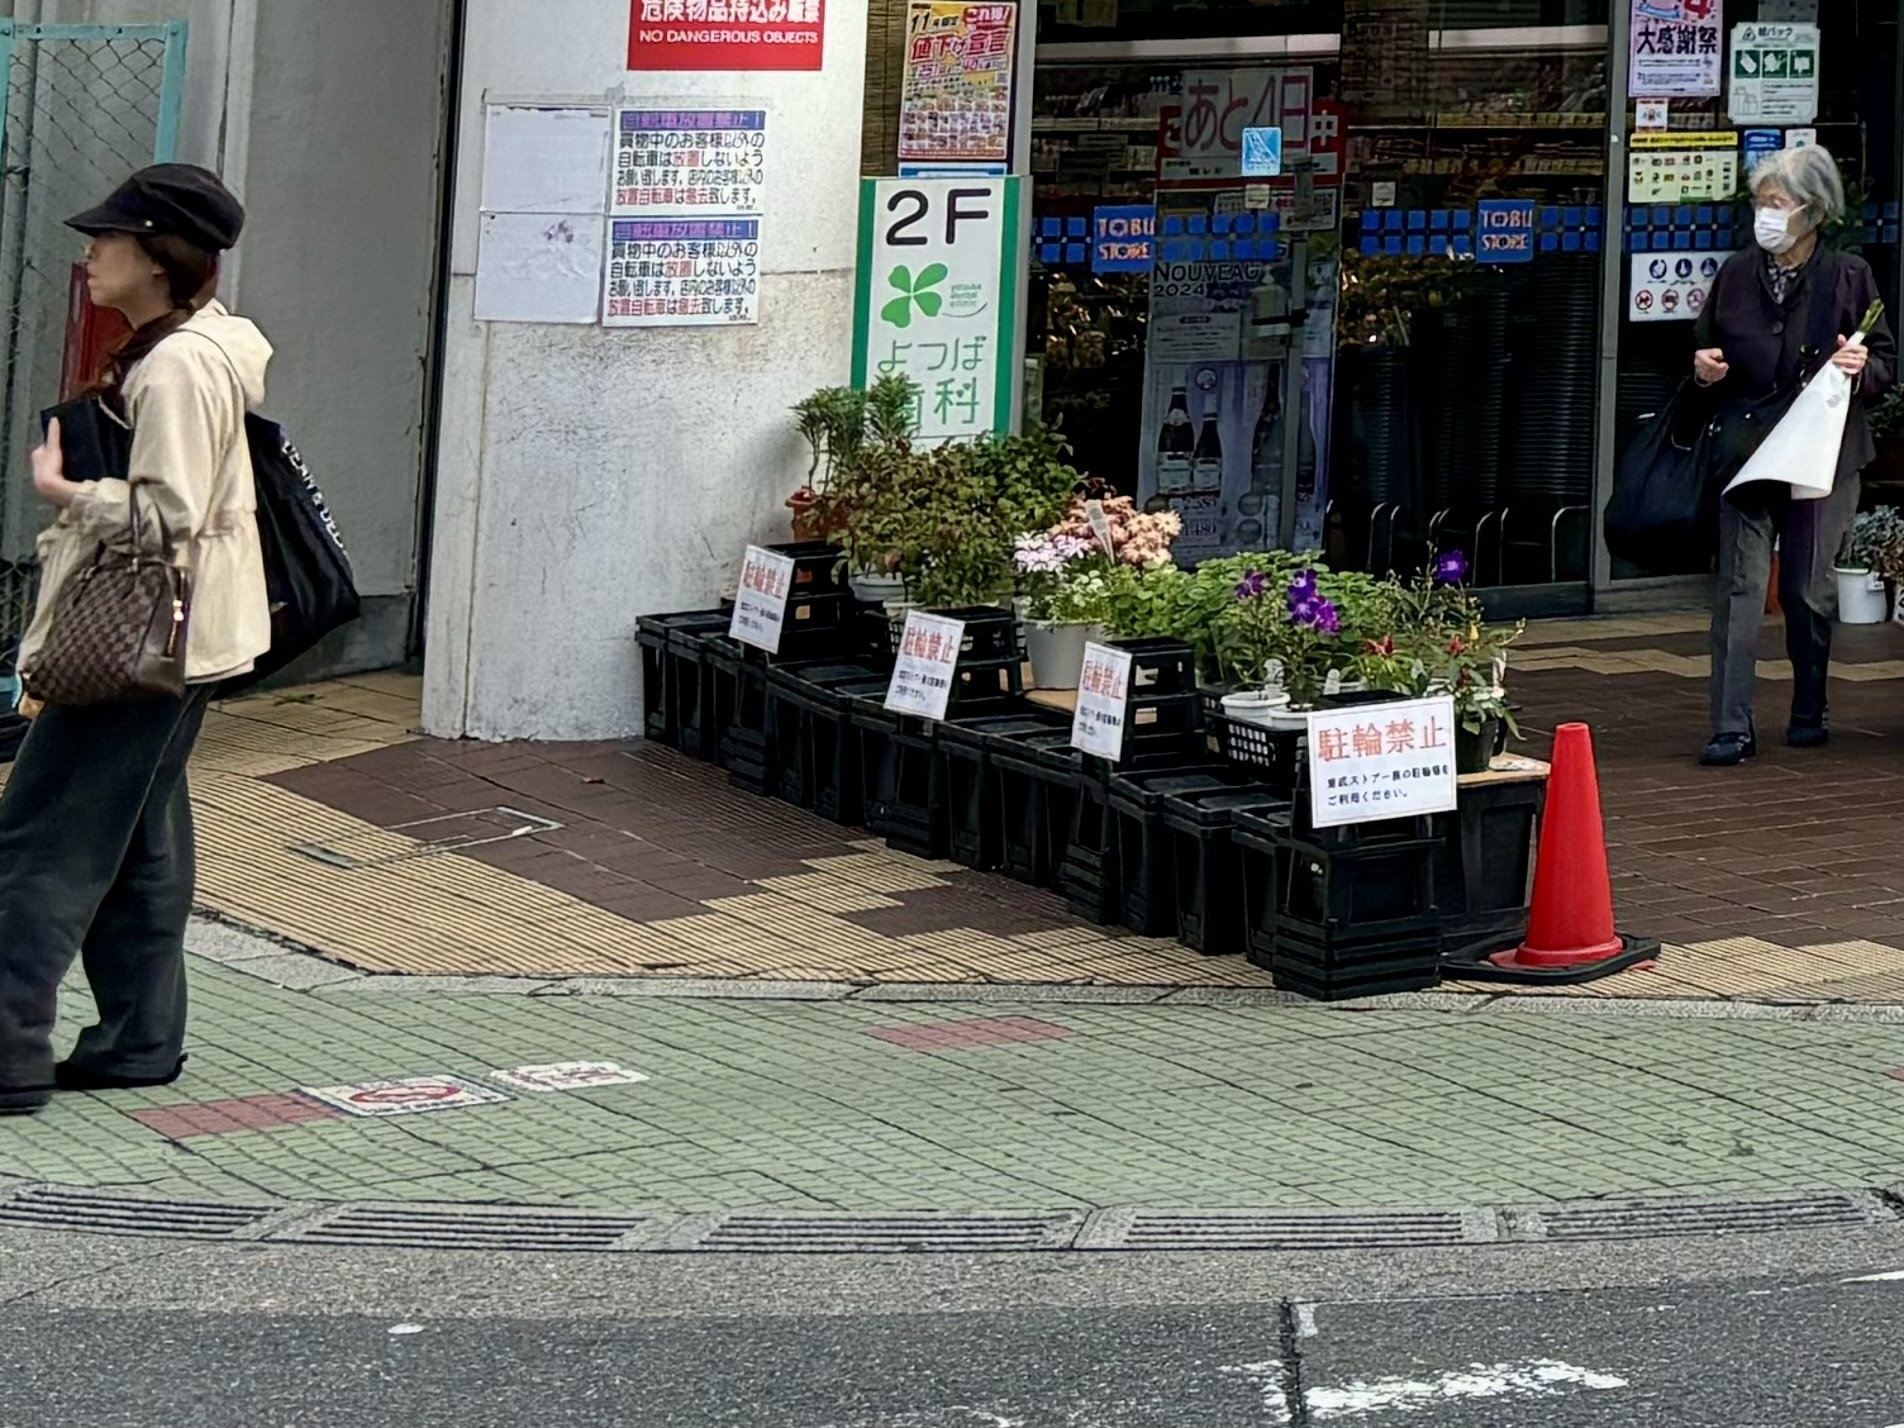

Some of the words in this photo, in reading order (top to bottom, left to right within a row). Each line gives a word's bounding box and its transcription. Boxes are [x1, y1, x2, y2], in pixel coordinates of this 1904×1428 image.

[640, 30, 663, 43] NO
[667, 30, 761, 44] DANGEROUS
[763, 31, 818, 44] OBJECTS
[1637, 24, 1718, 55] 大感謝祭
[886, 188, 992, 247] 2F
[1099, 218, 1155, 236] TOBU
[1481, 209, 1534, 229] TOBU
[1098, 243, 1151, 260] STORE
[1481, 234, 1529, 251] STORE
[877, 334, 987, 373] よつば
[1318, 715, 1447, 762] 駐輪禁止
